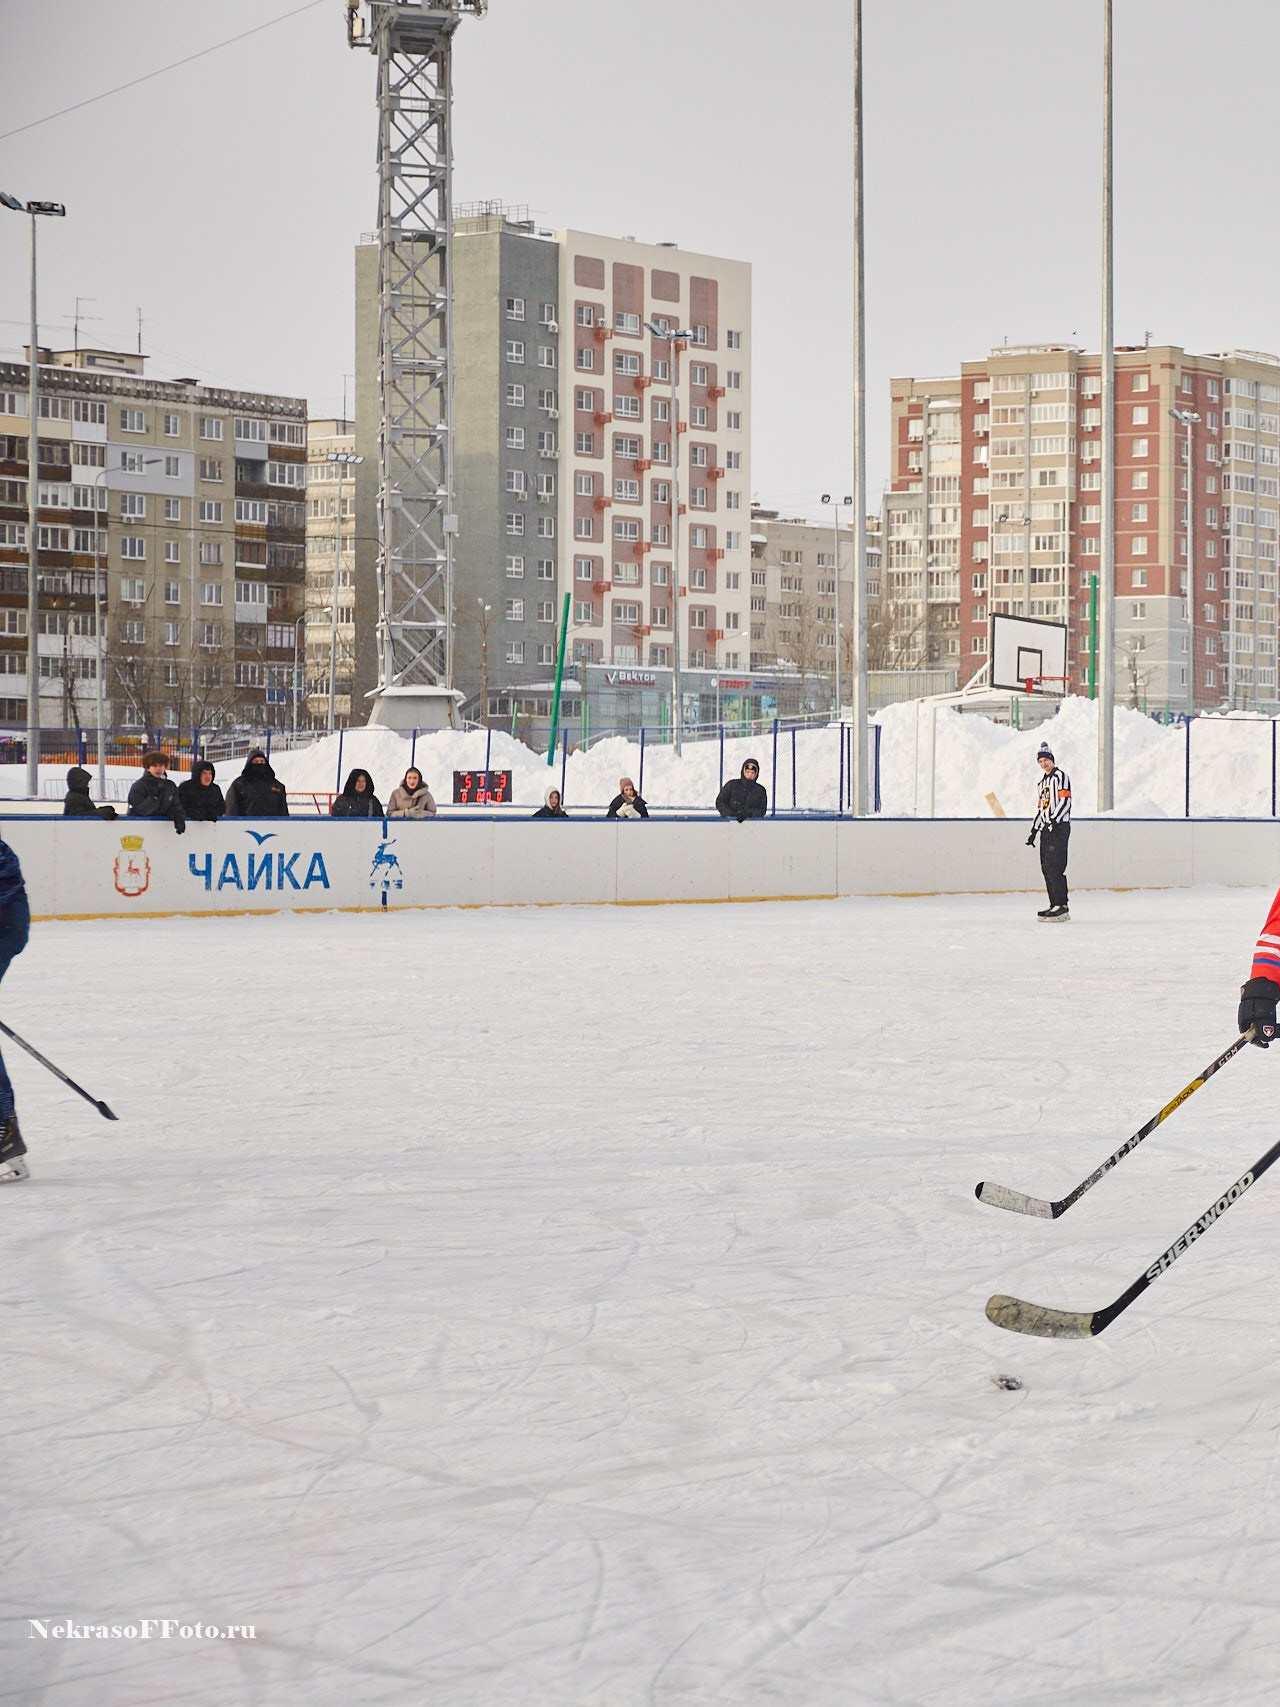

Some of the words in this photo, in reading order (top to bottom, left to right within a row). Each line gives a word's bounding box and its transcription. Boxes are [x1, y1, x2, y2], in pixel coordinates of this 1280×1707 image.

[465, 774, 472, 789] 5
[500, 774, 507, 789] 3
[461, 791, 468, 803] 0
[496, 791, 503, 802] 0
[188, 830, 331, 891] ЧАЙКА
[1217, 1046, 1239, 1067] CCM
